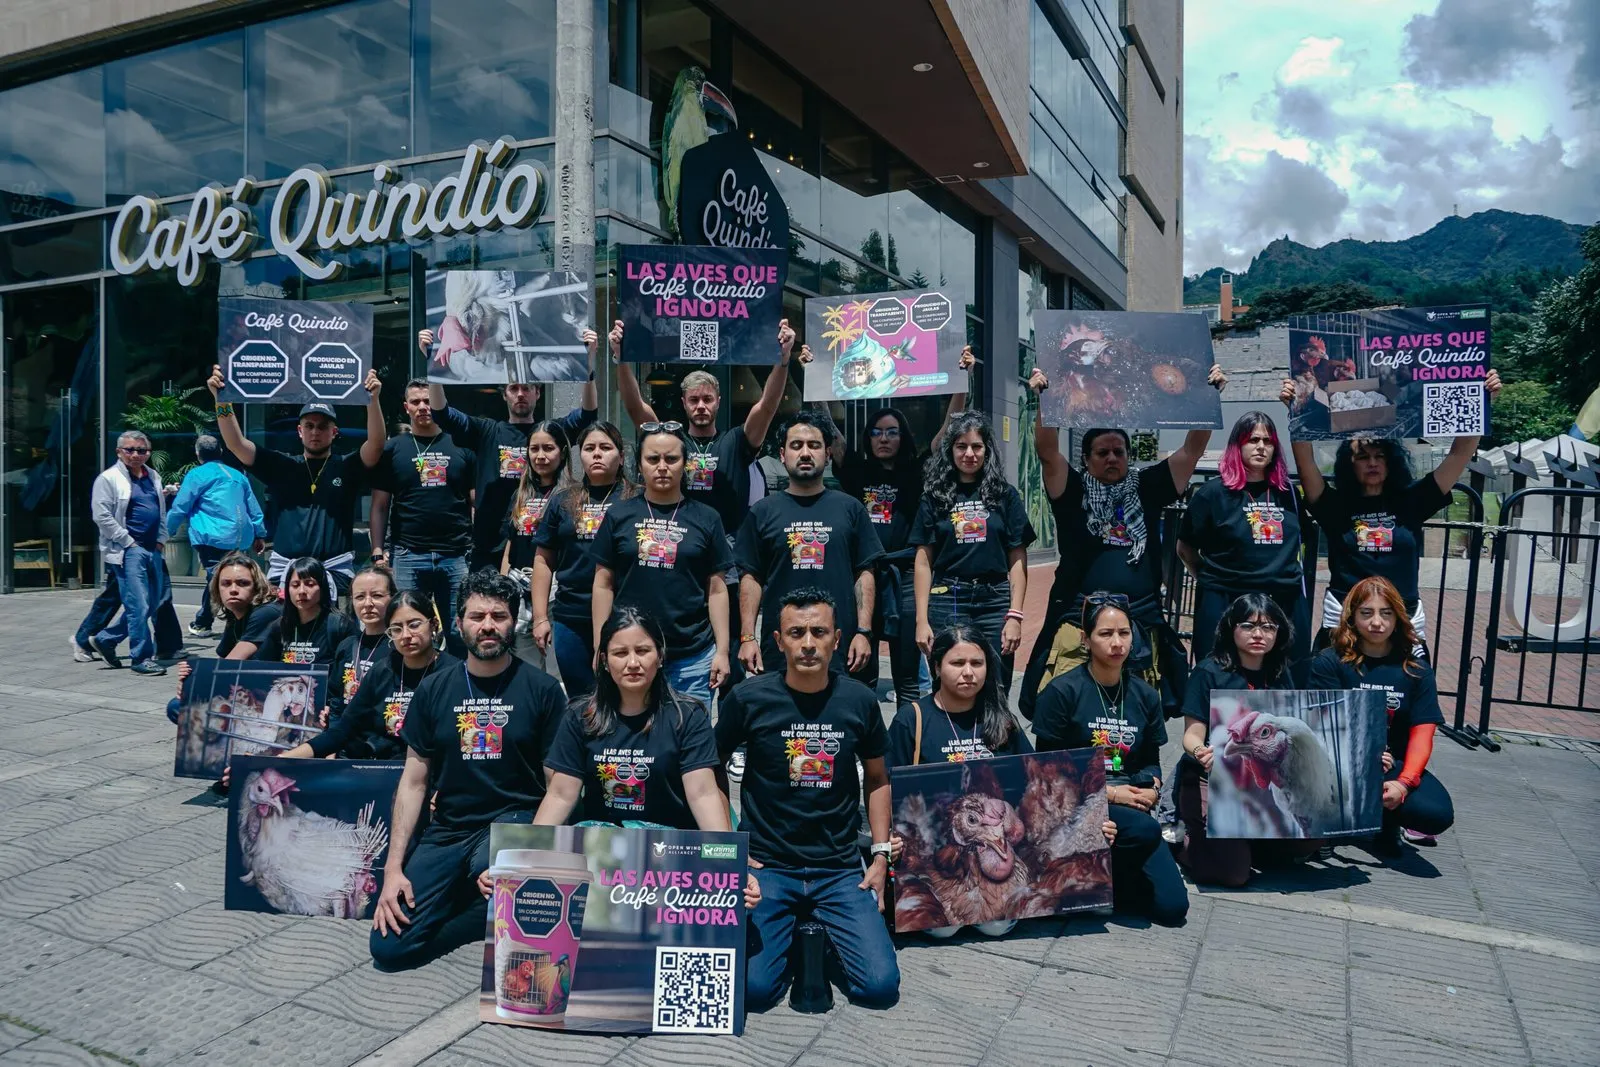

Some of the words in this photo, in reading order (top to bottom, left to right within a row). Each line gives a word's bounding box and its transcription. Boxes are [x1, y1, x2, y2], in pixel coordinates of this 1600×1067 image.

[720, 168, 769, 228] Café
[110, 178, 253, 287] Café
[270, 139, 542, 281] Quindío
[703, 200, 778, 248] Quindí
[627, 262, 667, 280] LAS
[672, 263, 727, 282] AVES
[733, 265, 778, 285] QUE
[639, 276, 687, 300] Café
[692, 277, 766, 303] Quindío
[656, 298, 750, 319] IGNORA
[244, 312, 284, 331] Café
[288, 313, 349, 333] Quindío
[1360, 336, 1393, 350] LAS
[1397, 333, 1443, 348] AVES
[1447, 330, 1486, 347] QUE
[232, 361, 285, 369] TRANSPARENTE
[1370, 349, 1414, 369] Café
[1418, 346, 1486, 368] Quindío
[1412, 365, 1487, 381] IGNORA
[600, 869, 637, 887] LAS
[641, 870, 693, 888] AVES
[698, 872, 740, 891] QUE
[516, 898, 561, 907] TRANSPARENTE
[610, 884, 659, 910] Café
[664, 886, 738, 913] Quindío
[656, 907, 739, 926] IGNORA
